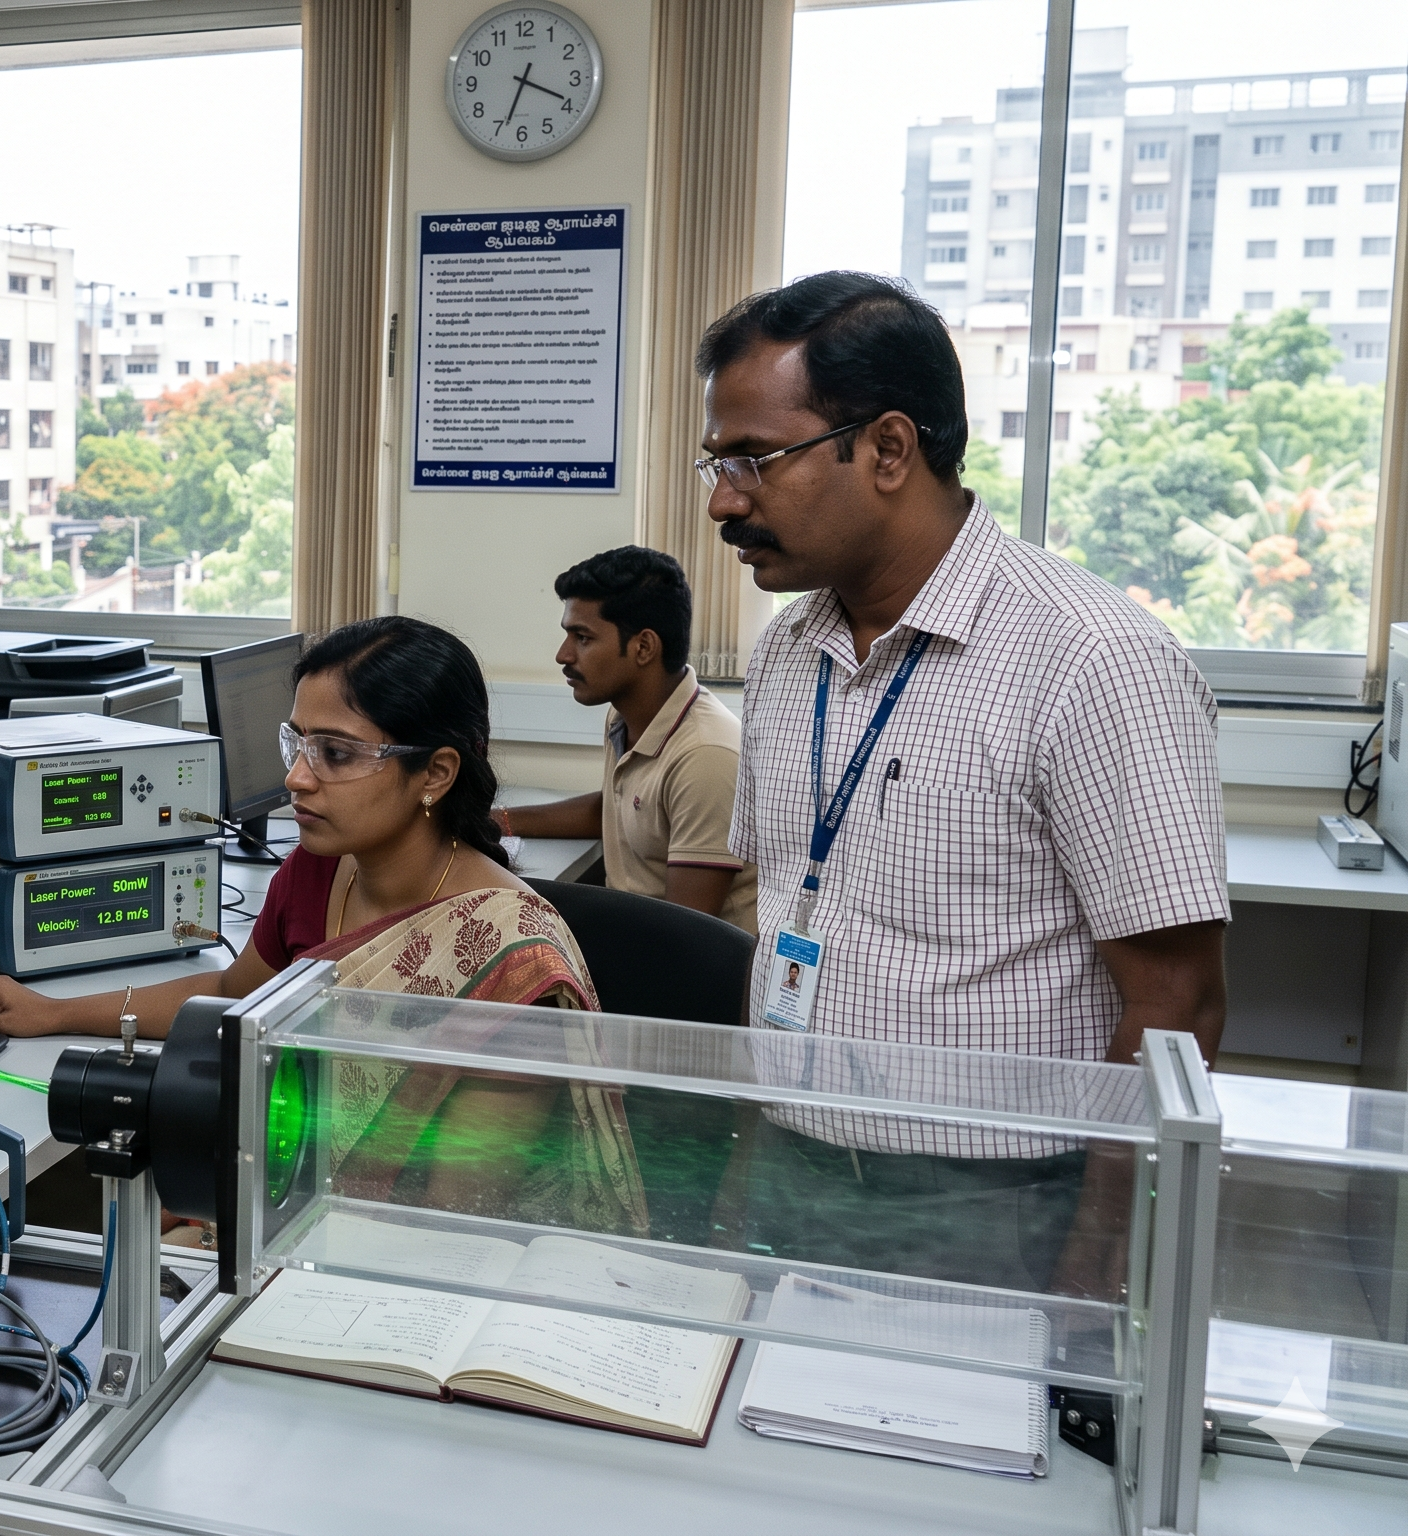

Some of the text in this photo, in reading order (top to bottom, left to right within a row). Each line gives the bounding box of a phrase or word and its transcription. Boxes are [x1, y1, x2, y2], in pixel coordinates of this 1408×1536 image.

[515, 20, 535, 38] 12
[546, 26, 554, 43] 1
[491, 30, 506, 47] 11
[472, 50, 491, 67] 10
[562, 43, 575, 61] 2
[466, 76, 478, 93] 9
[568, 70, 581, 87] 3
[473, 102, 485, 119] 8
[560, 98, 574, 115] 4
[493, 120, 505, 137] 7
[516, 125, 528, 142] 6
[541, 118, 554, 135] 5
[30, 876, 149, 904] Laser Power: 50mW
[37, 906, 150, 933] Velocity: 12.8 m/s
